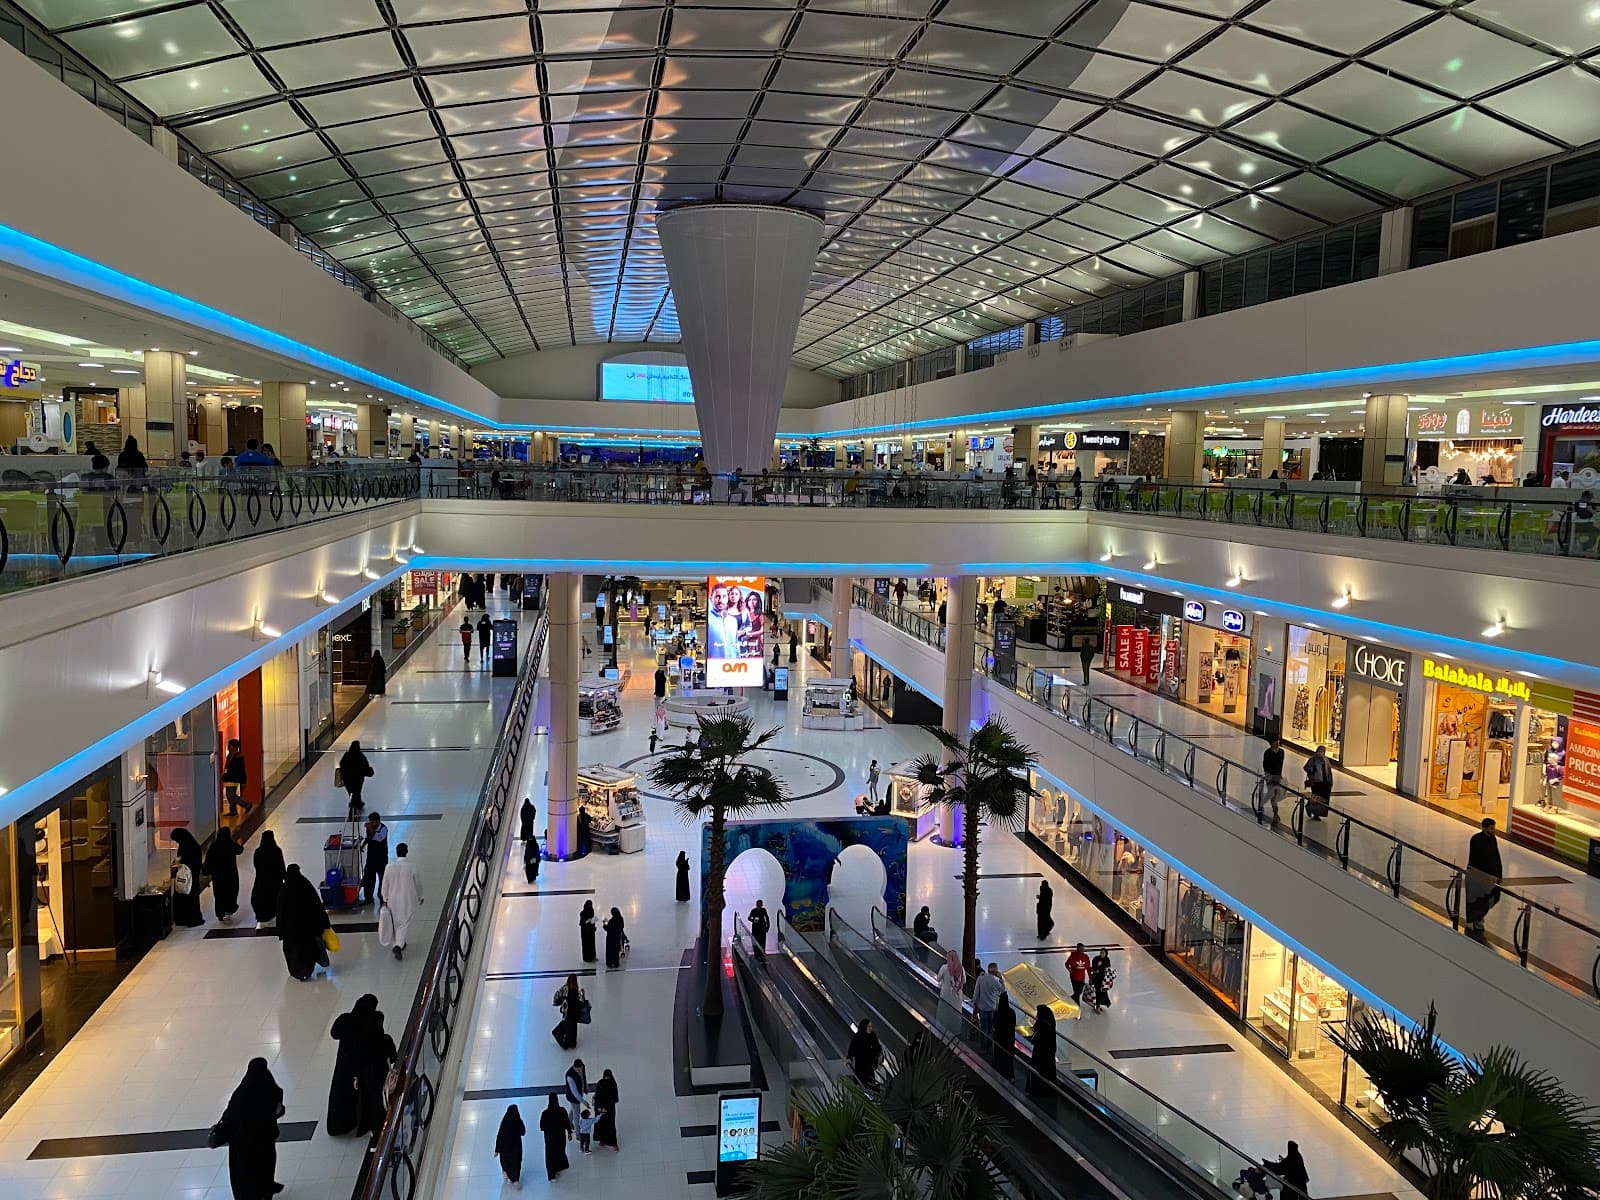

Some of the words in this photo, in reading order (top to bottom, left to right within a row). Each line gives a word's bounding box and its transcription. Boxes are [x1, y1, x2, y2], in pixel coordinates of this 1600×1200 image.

[332, 634, 352, 642] ext
[1120, 638, 1130, 668] SALE
[1134, 640, 1145, 675] تخفيضات
[1150, 649, 1161, 681] SALE
[1165, 652, 1175, 681] تخفيضا
[1354, 645, 1406, 687] CHOICE
[1423, 659, 1494, 692] Balabala
